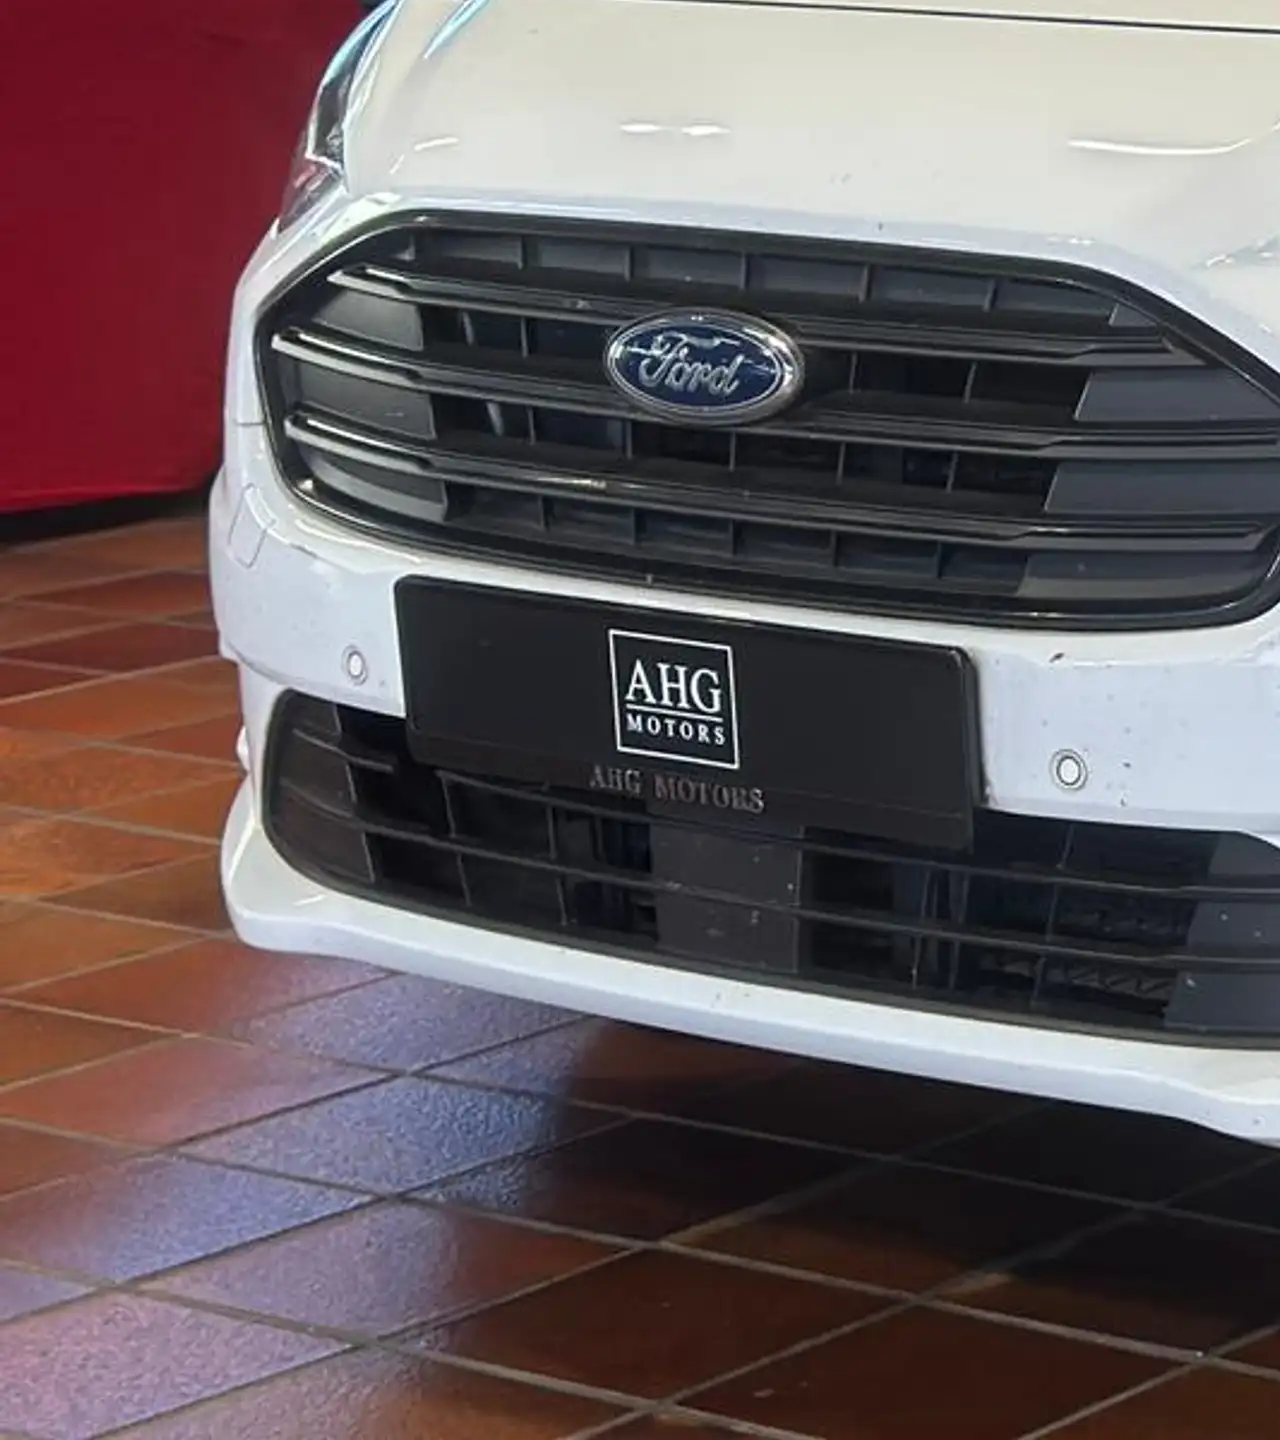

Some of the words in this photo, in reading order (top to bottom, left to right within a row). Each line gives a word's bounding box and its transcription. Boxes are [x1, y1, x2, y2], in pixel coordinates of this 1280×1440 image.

[628, 332, 742, 394] Ford
[625, 659, 722, 713] AHG
[626, 713, 725, 745] MOTORS
[589, 765, 642, 794] AHG
[655, 774, 765, 814] MOTORS
